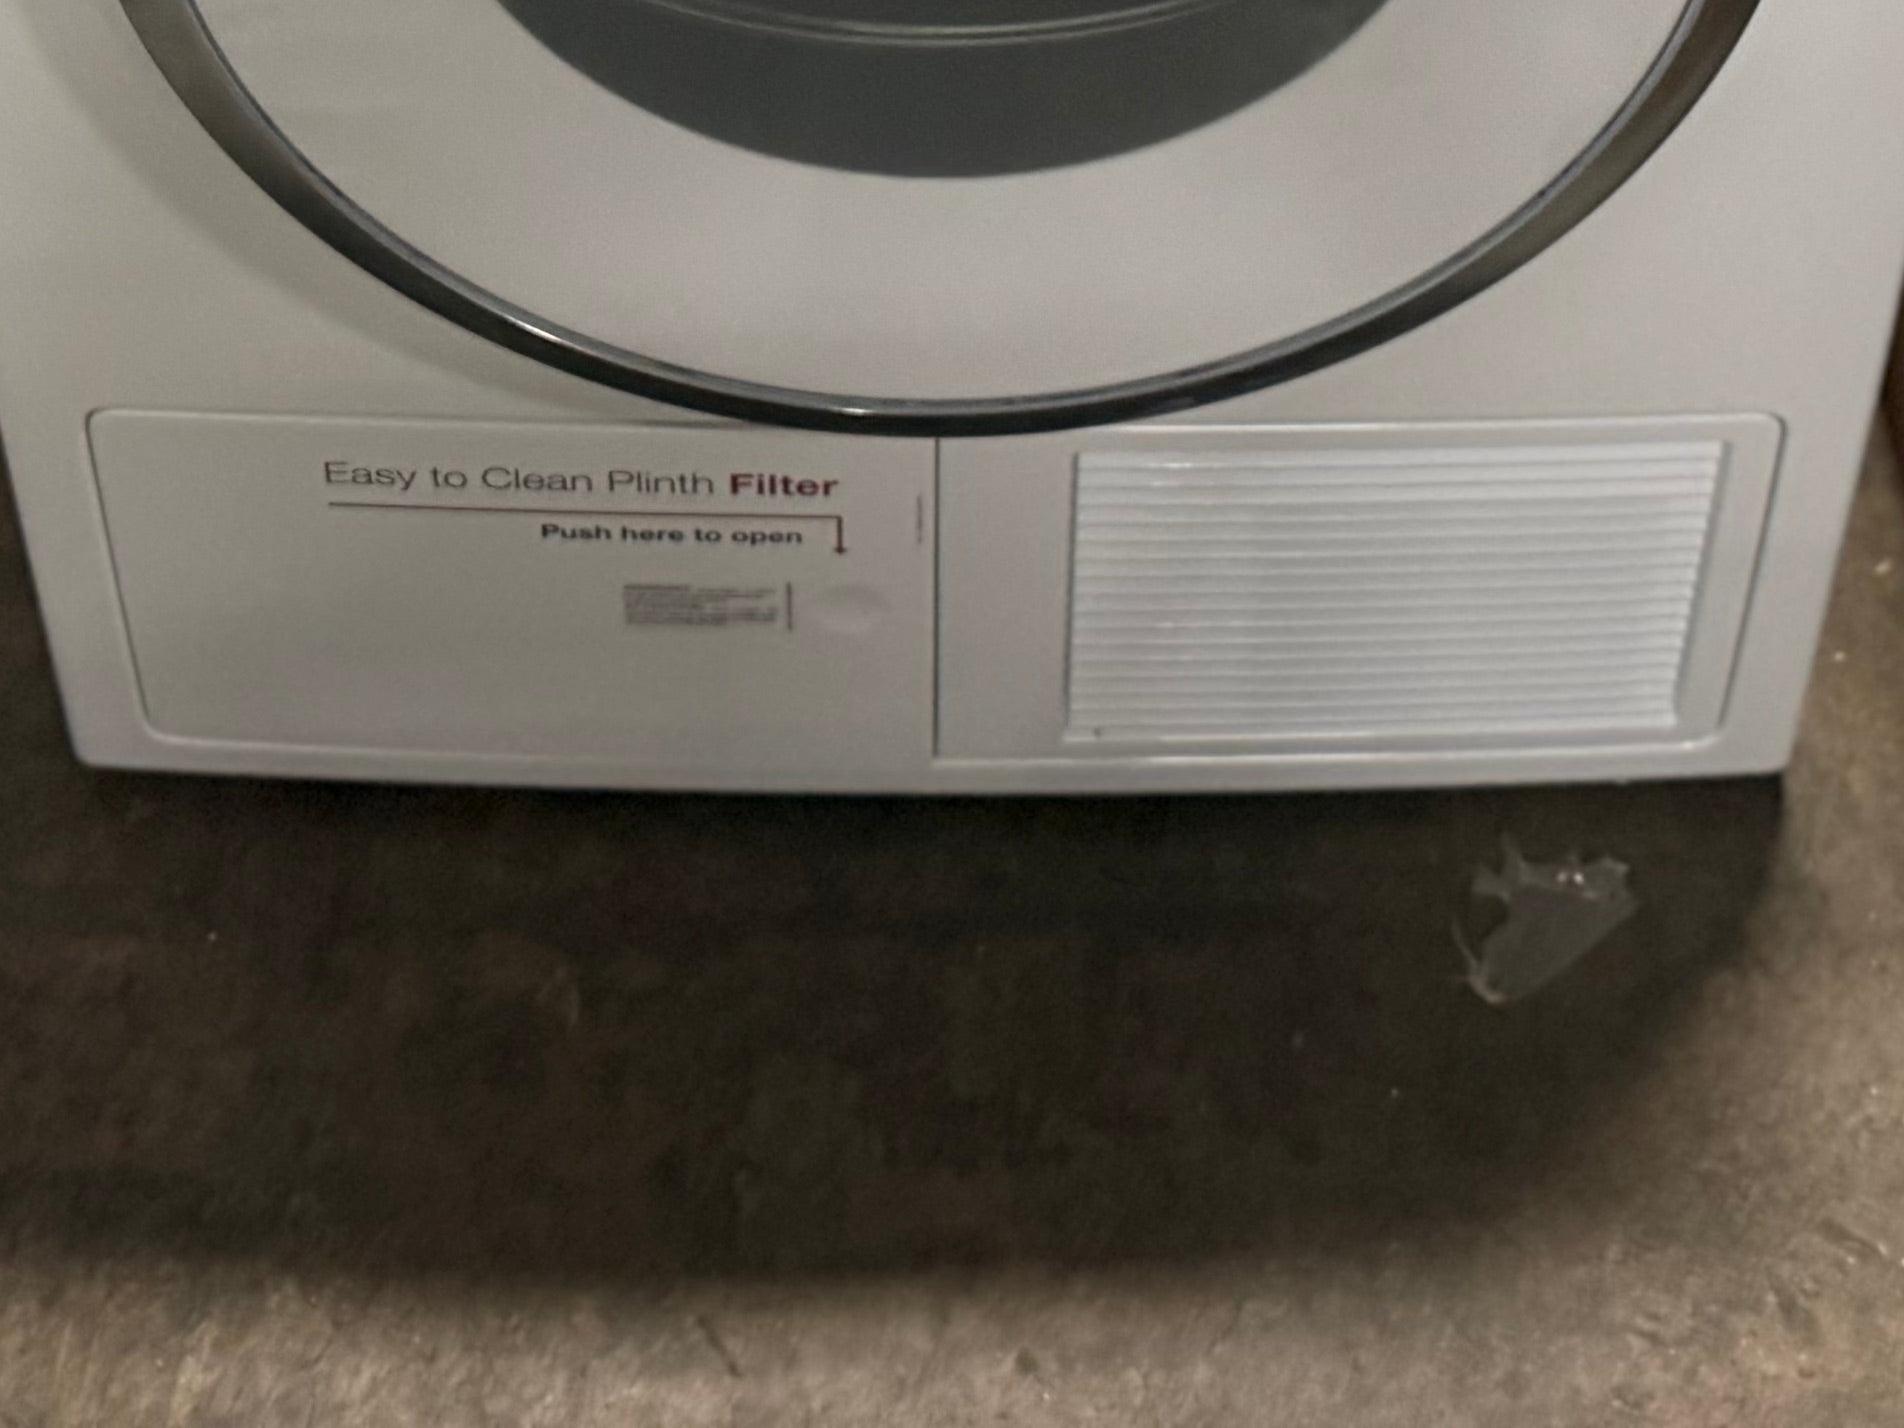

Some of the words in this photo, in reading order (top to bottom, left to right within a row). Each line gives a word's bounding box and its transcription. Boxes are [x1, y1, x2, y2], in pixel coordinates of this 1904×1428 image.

[323, 460, 416, 491] Easy
[430, 466, 468, 490] to
[481, 465, 594, 493] Clean
[608, 469, 715, 496] Plinth
[729, 472, 840, 498] Filter
[540, 522, 612, 542] Push
[621, 524, 684, 543] here
[694, 526, 722, 544] to
[731, 527, 803, 546] open
